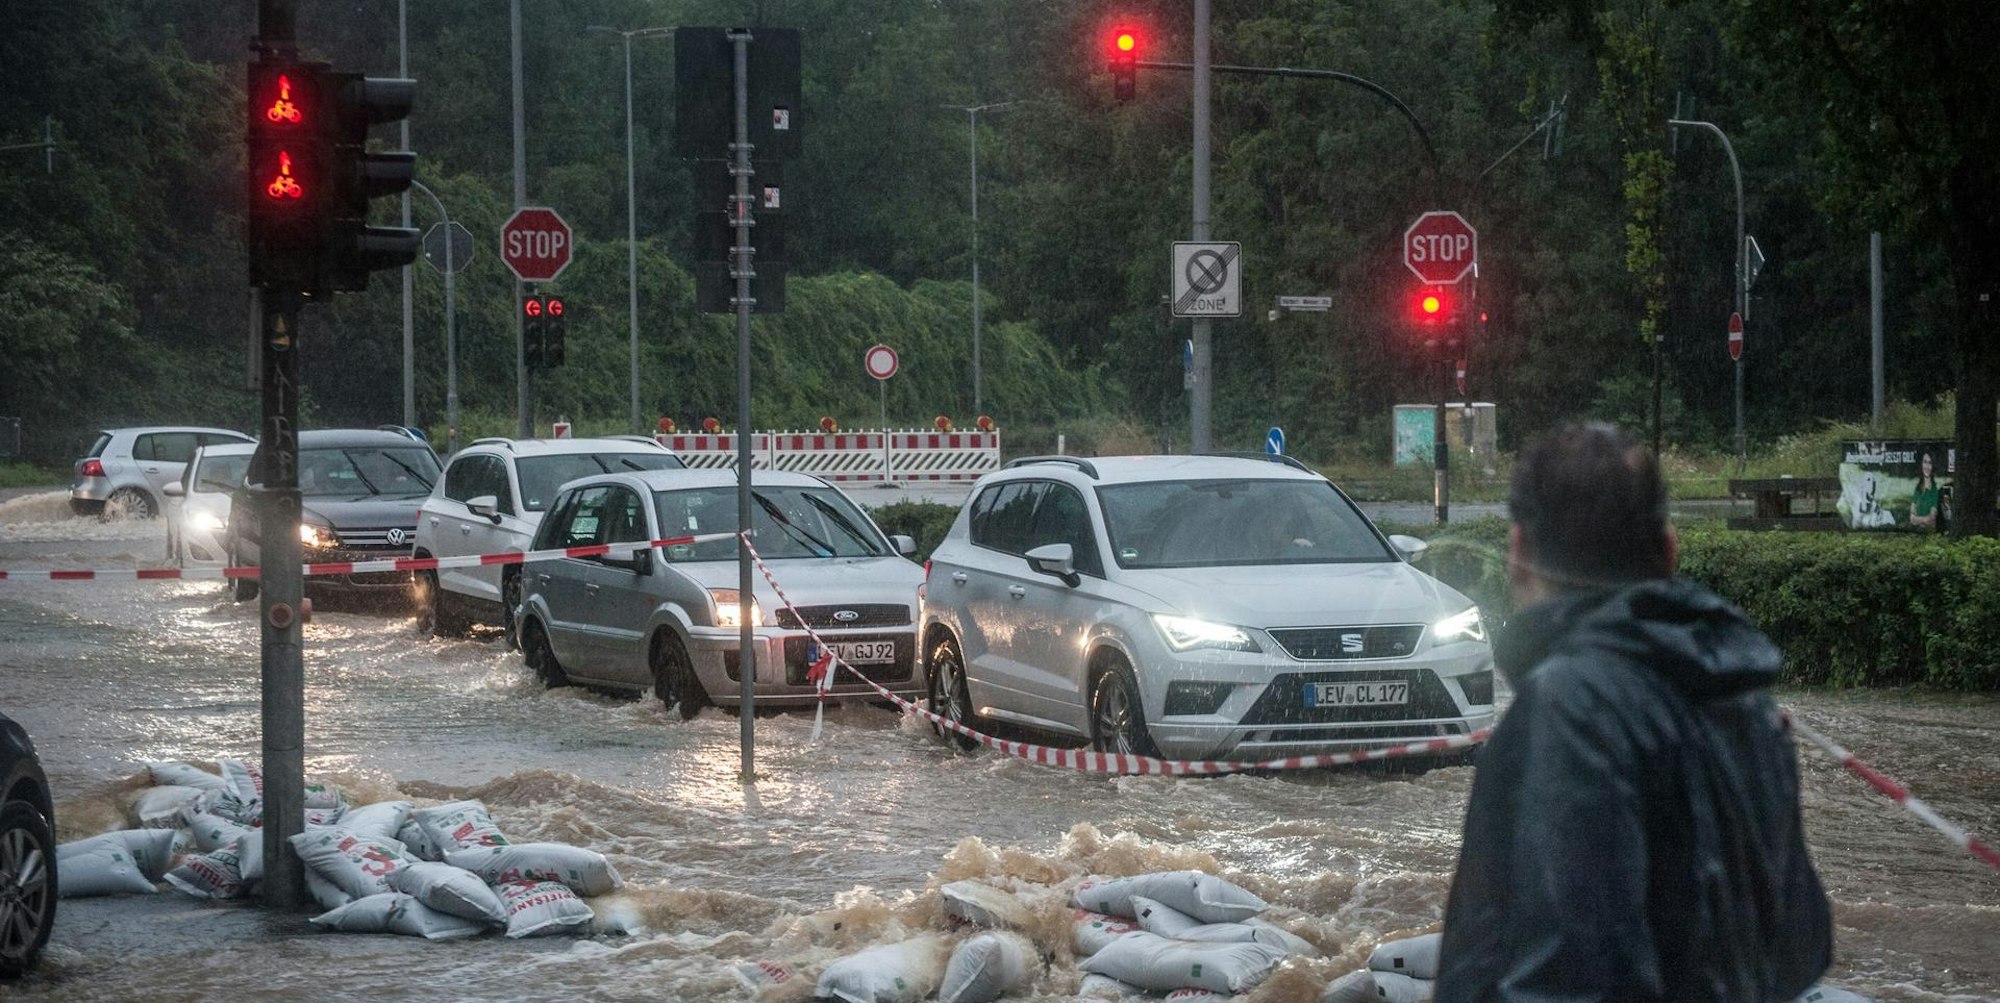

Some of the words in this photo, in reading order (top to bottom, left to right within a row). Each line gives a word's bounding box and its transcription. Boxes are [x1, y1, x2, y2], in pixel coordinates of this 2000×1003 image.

[508, 229, 565, 258] STOP
[1412, 233, 1470, 262] STOP
[1190, 298, 1224, 311] ZONE
[855, 644, 874, 659] GJ
[876, 643, 893, 658] 92
[1315, 686, 1345, 704] LEV
[1356, 685, 1375, 702] CL
[1379, 684, 1407, 702] 177
